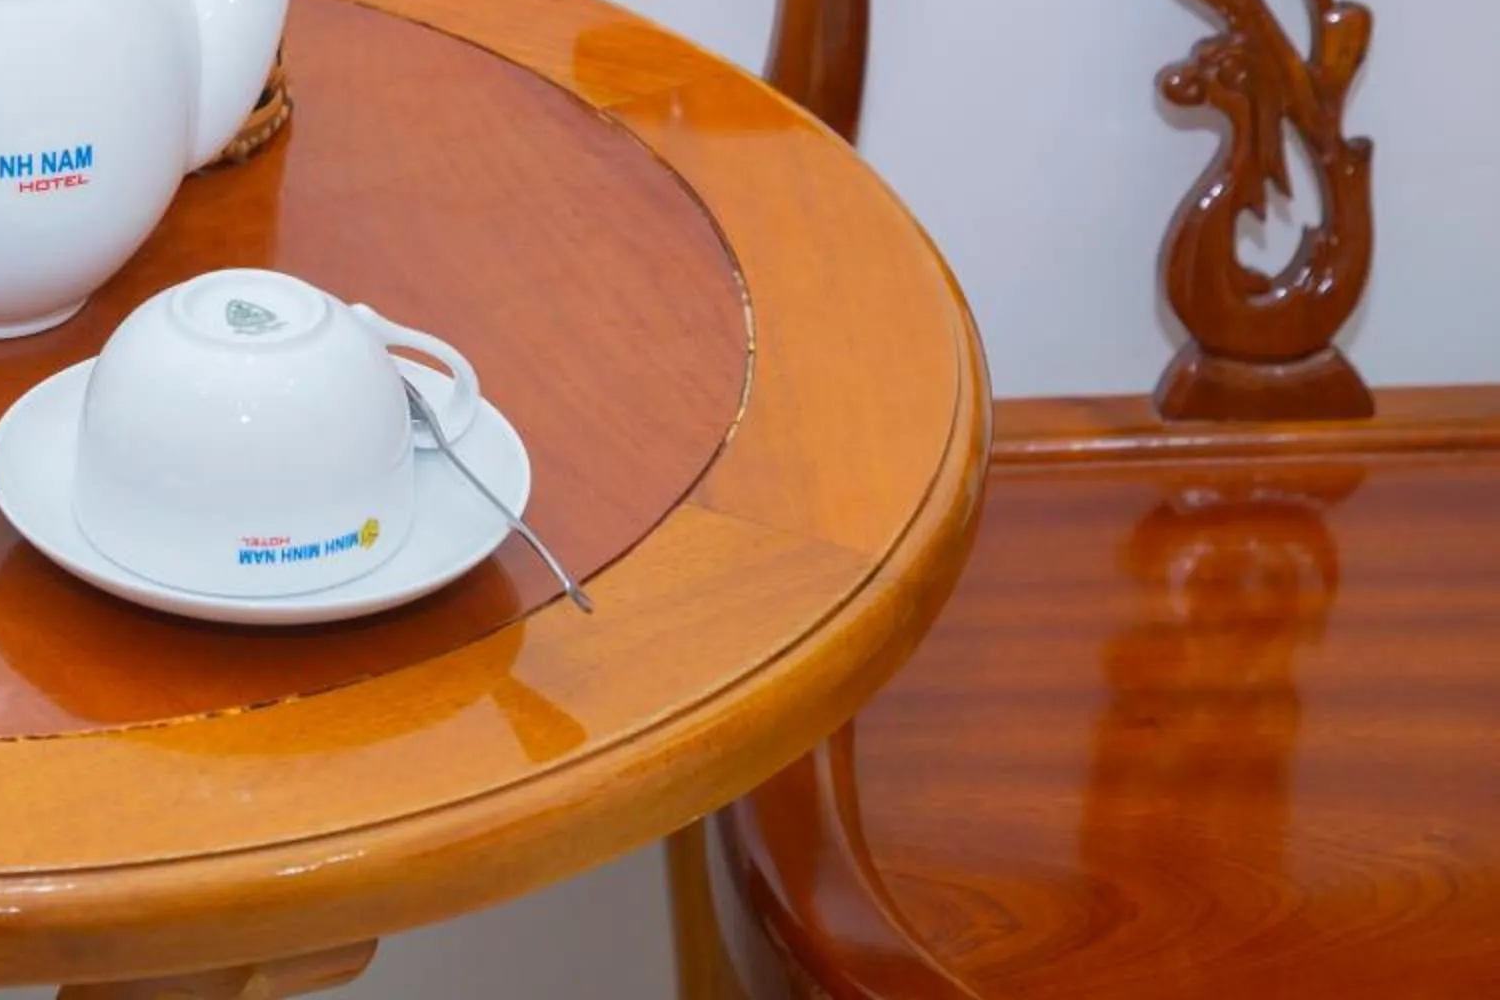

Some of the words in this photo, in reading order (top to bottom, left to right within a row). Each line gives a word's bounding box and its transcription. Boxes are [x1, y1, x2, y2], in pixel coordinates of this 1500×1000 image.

[40, 144, 94, 174] NAM
[18, 174, 91, 193] HOTEL
[324, 530, 359, 555] MINH
[238, 549, 276, 565] NAM
[281, 543, 320, 563] MINH
